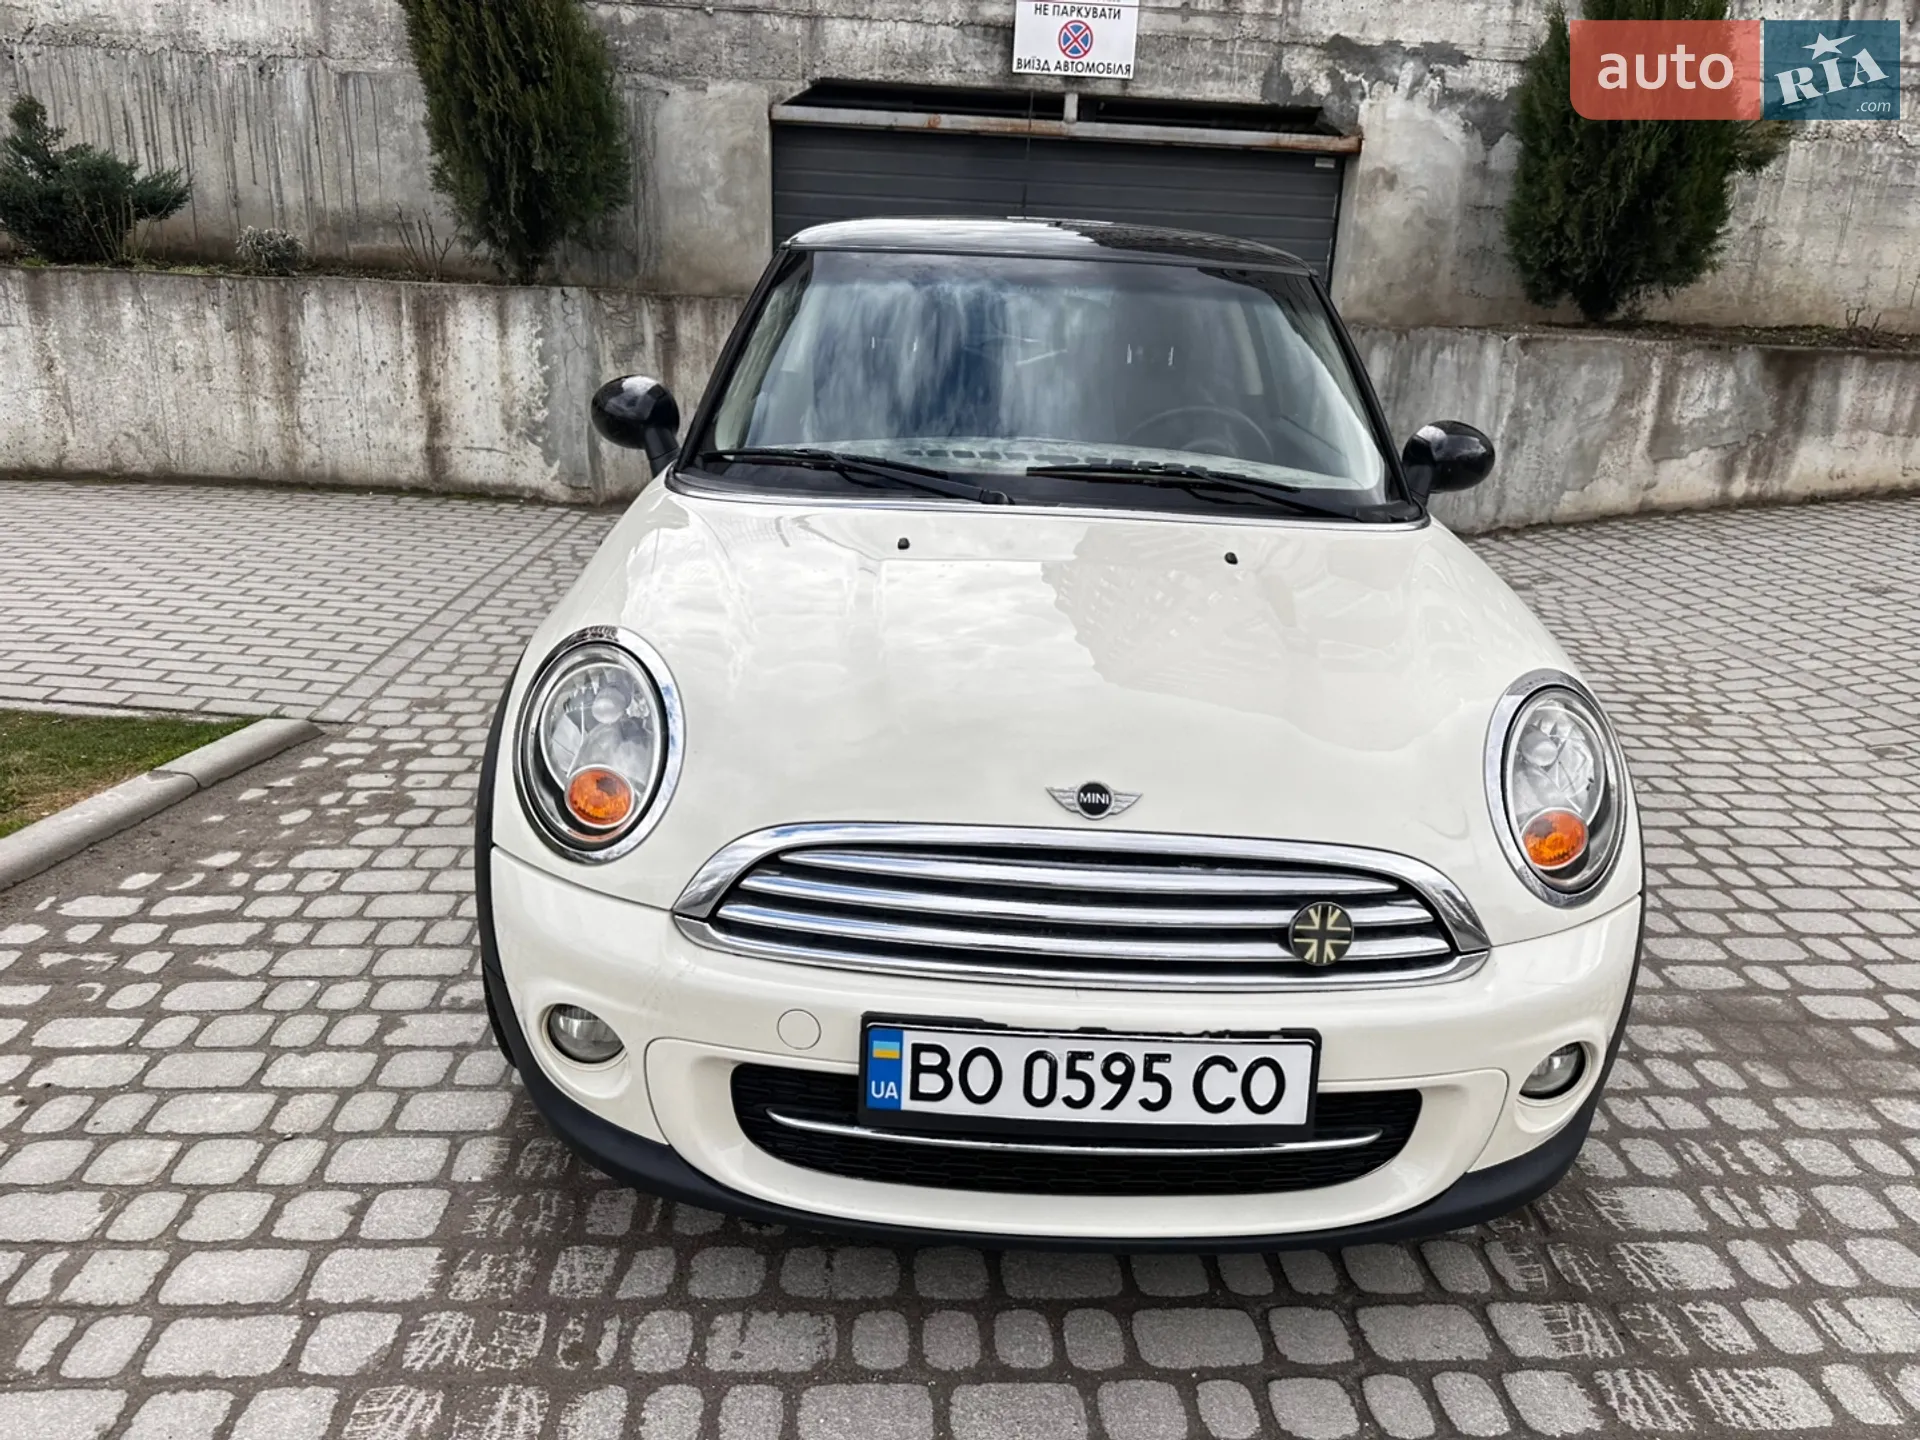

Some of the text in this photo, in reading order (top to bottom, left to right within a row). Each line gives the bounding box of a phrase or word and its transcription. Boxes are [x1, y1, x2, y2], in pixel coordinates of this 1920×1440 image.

[1034, 3, 1121, 20] НЕ ПАРКУВАТИ
[1016, 56, 1131, 75] ВИЇЗД АВТОМОБІЛЯ
[1079, 791, 1109, 805] MINI
[909, 1042, 1286, 1115] BO 0595 CO
[871, 1080, 899, 1100] UA
